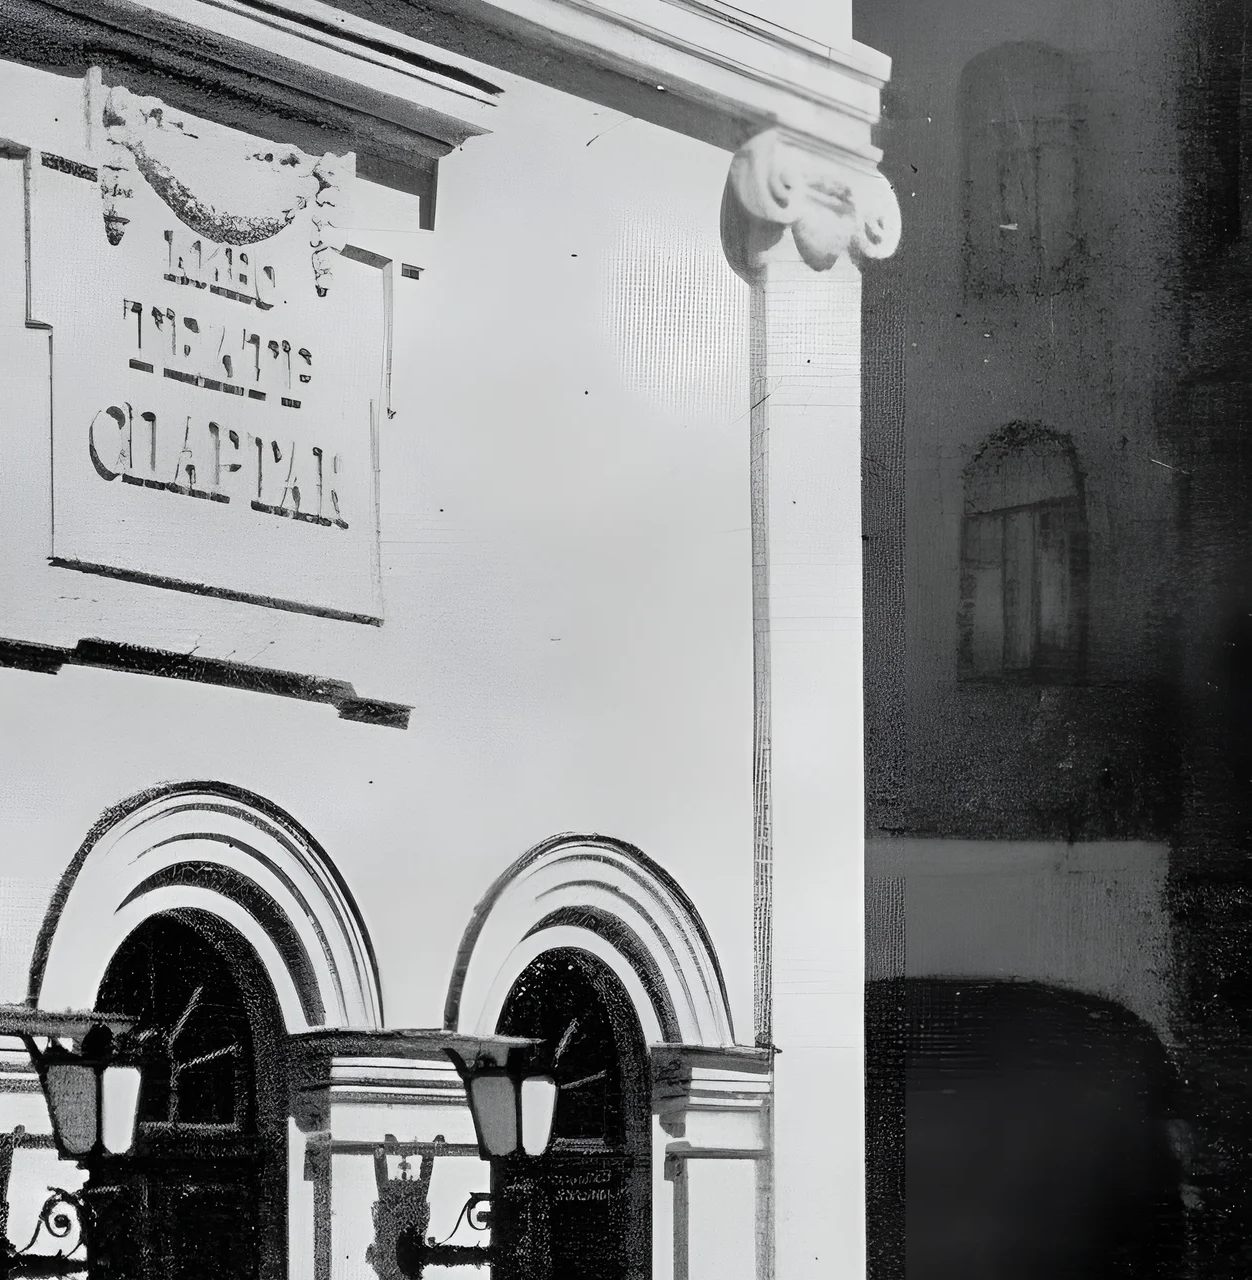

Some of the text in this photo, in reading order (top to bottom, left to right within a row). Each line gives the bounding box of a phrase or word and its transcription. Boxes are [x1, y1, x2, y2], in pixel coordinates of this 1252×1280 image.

[162, 229, 277, 311] КИНО
[122, 297, 313, 409] ТЕАТР
[88, 401, 350, 531] СПАРТАК
